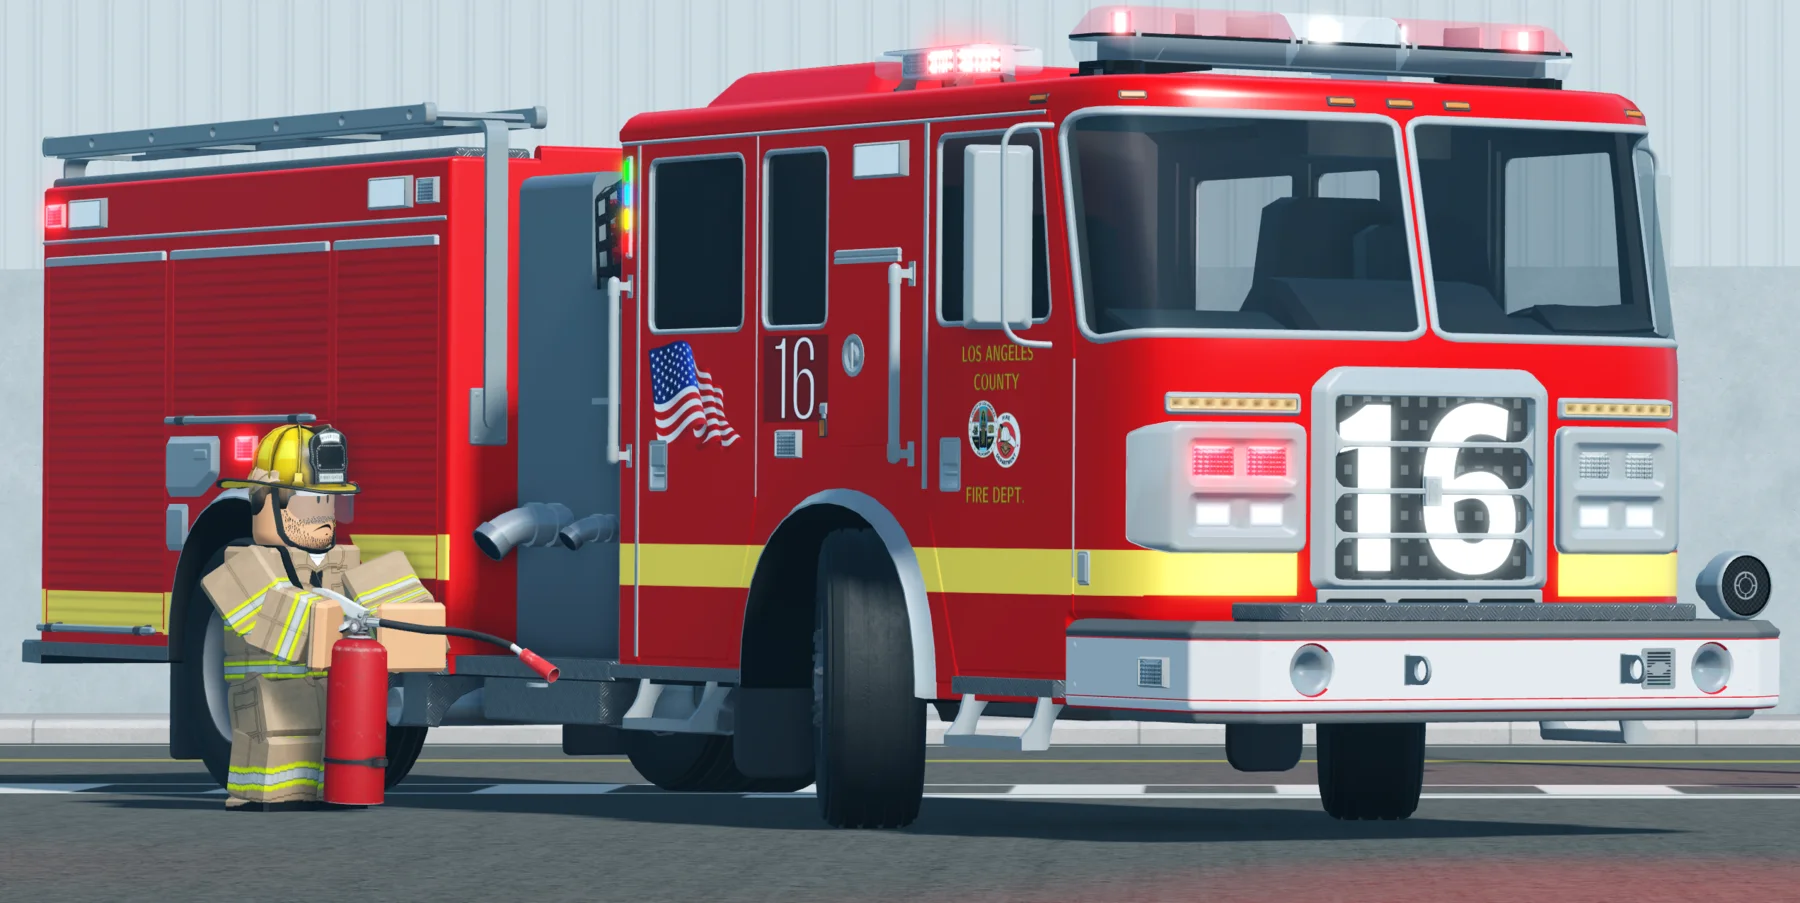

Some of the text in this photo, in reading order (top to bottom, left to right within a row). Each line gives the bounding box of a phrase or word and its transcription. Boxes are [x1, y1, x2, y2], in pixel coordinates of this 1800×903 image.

[962, 344, 1034, 362] LOS ANGELES
[774, 336, 815, 420] 16
[973, 373, 1020, 391] COUNTY
[966, 486, 1025, 504] FIRE DEPT.
[1339, 402, 1517, 576] 16
